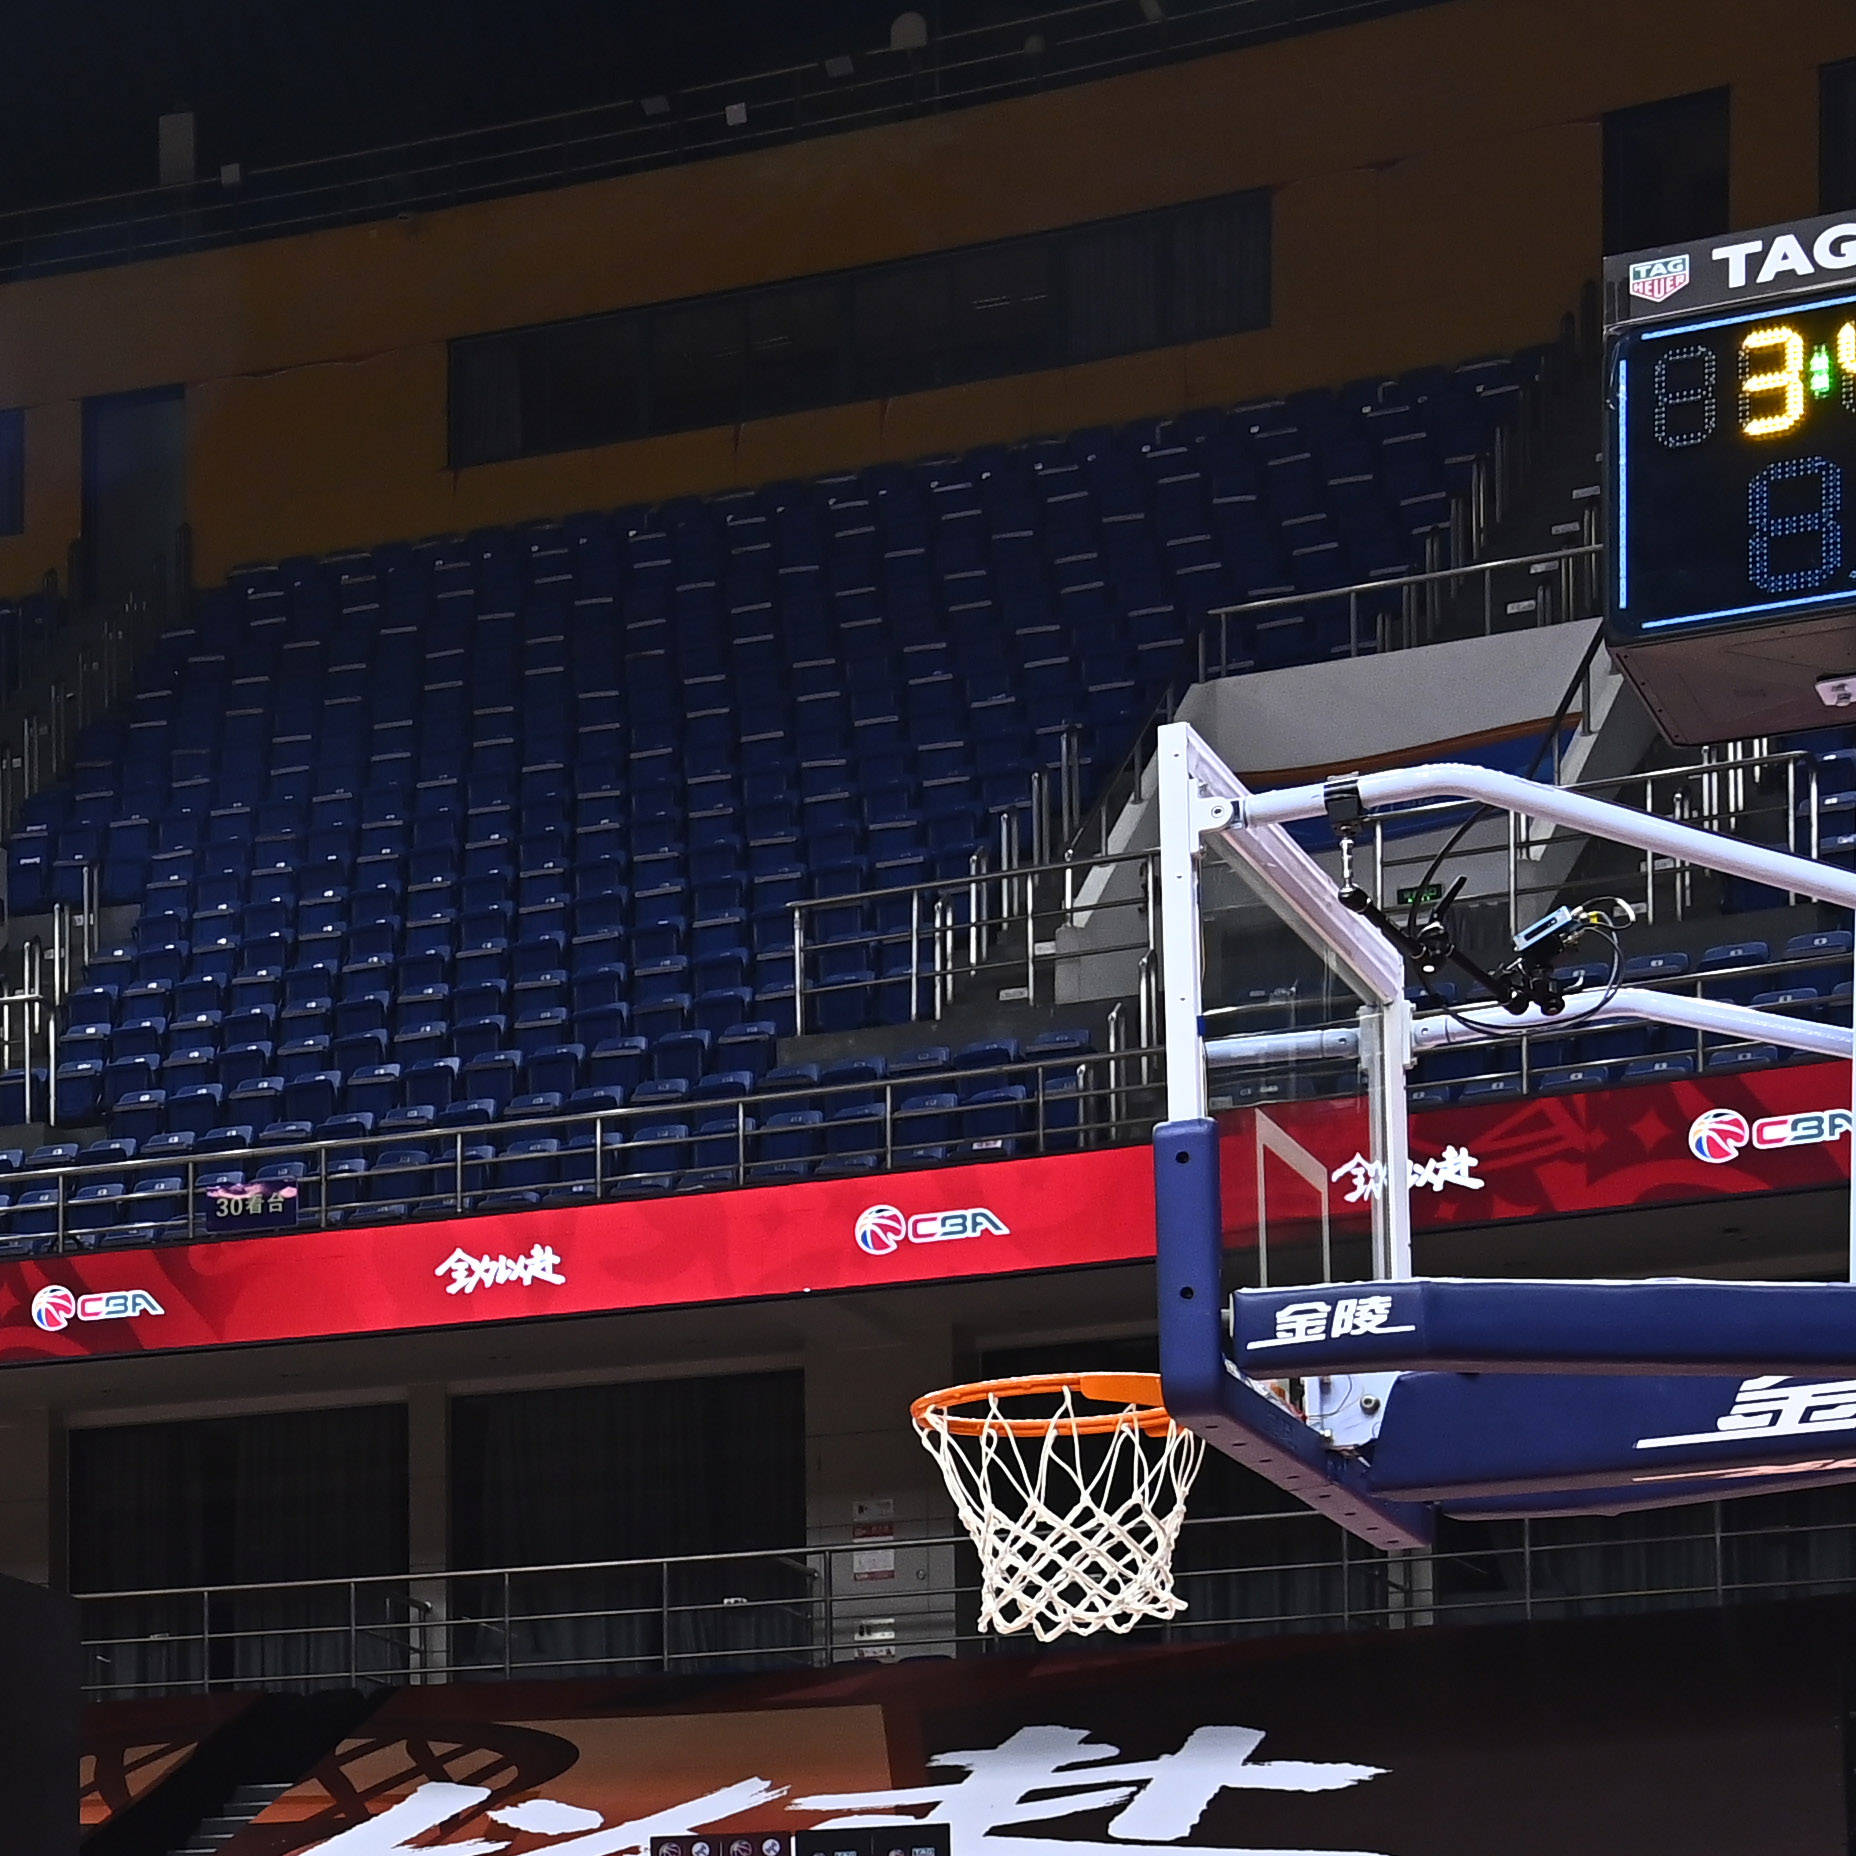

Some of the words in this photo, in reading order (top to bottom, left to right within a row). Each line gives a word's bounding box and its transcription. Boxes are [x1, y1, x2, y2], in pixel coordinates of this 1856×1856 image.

[1635, 258, 1685, 275] TAG
[1632, 276, 1688, 298] HEUER
[908, 1207, 1010, 1243] CBA
[77, 1289, 164, 1321] CBA
[1246, 1295, 1416, 1350] 金陵
